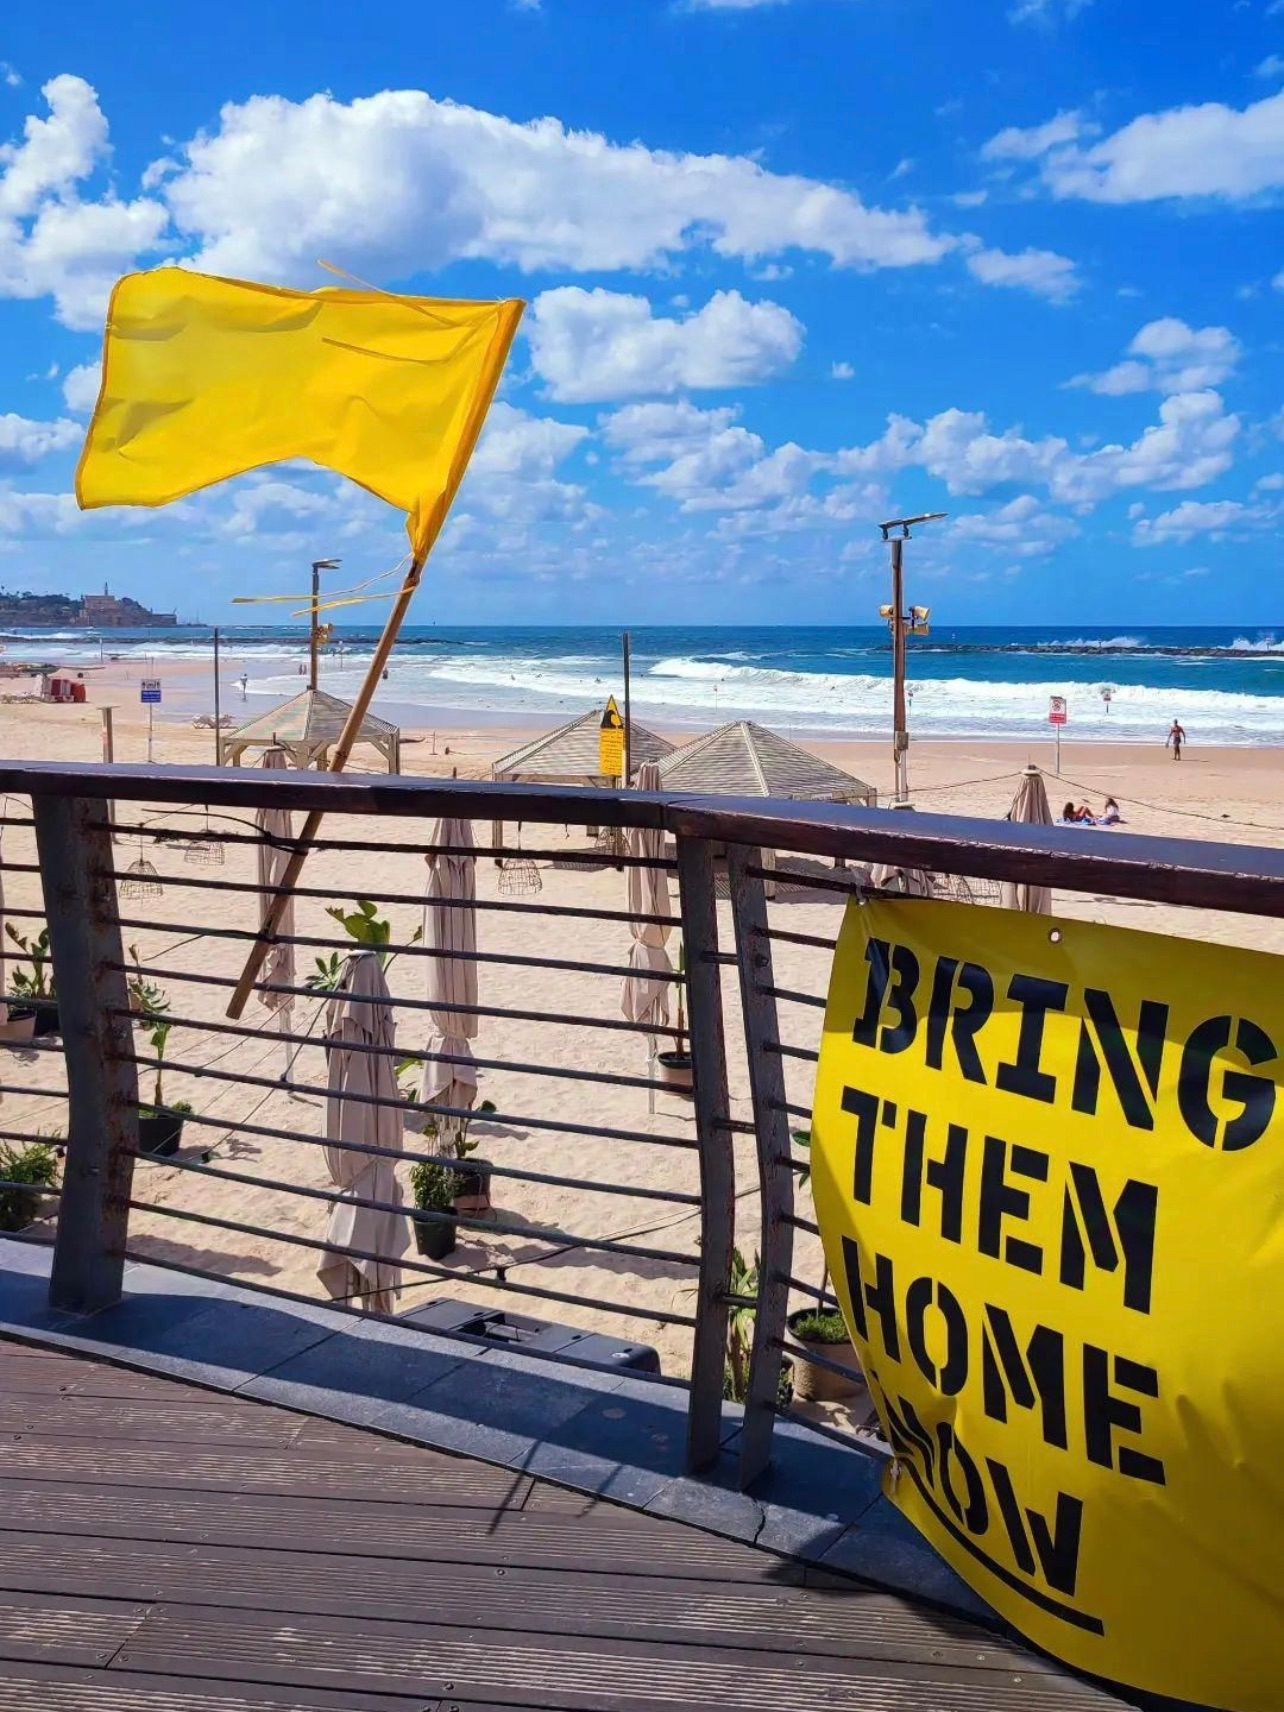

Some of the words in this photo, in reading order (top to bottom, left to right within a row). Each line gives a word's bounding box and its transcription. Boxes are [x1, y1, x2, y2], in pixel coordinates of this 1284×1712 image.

[853, 937, 1279, 1151] BRING
[841, 1086, 1158, 1314] THEM
[841, 1235, 1165, 1485] HOME
[870, 1369, 1084, 1597] NOW
